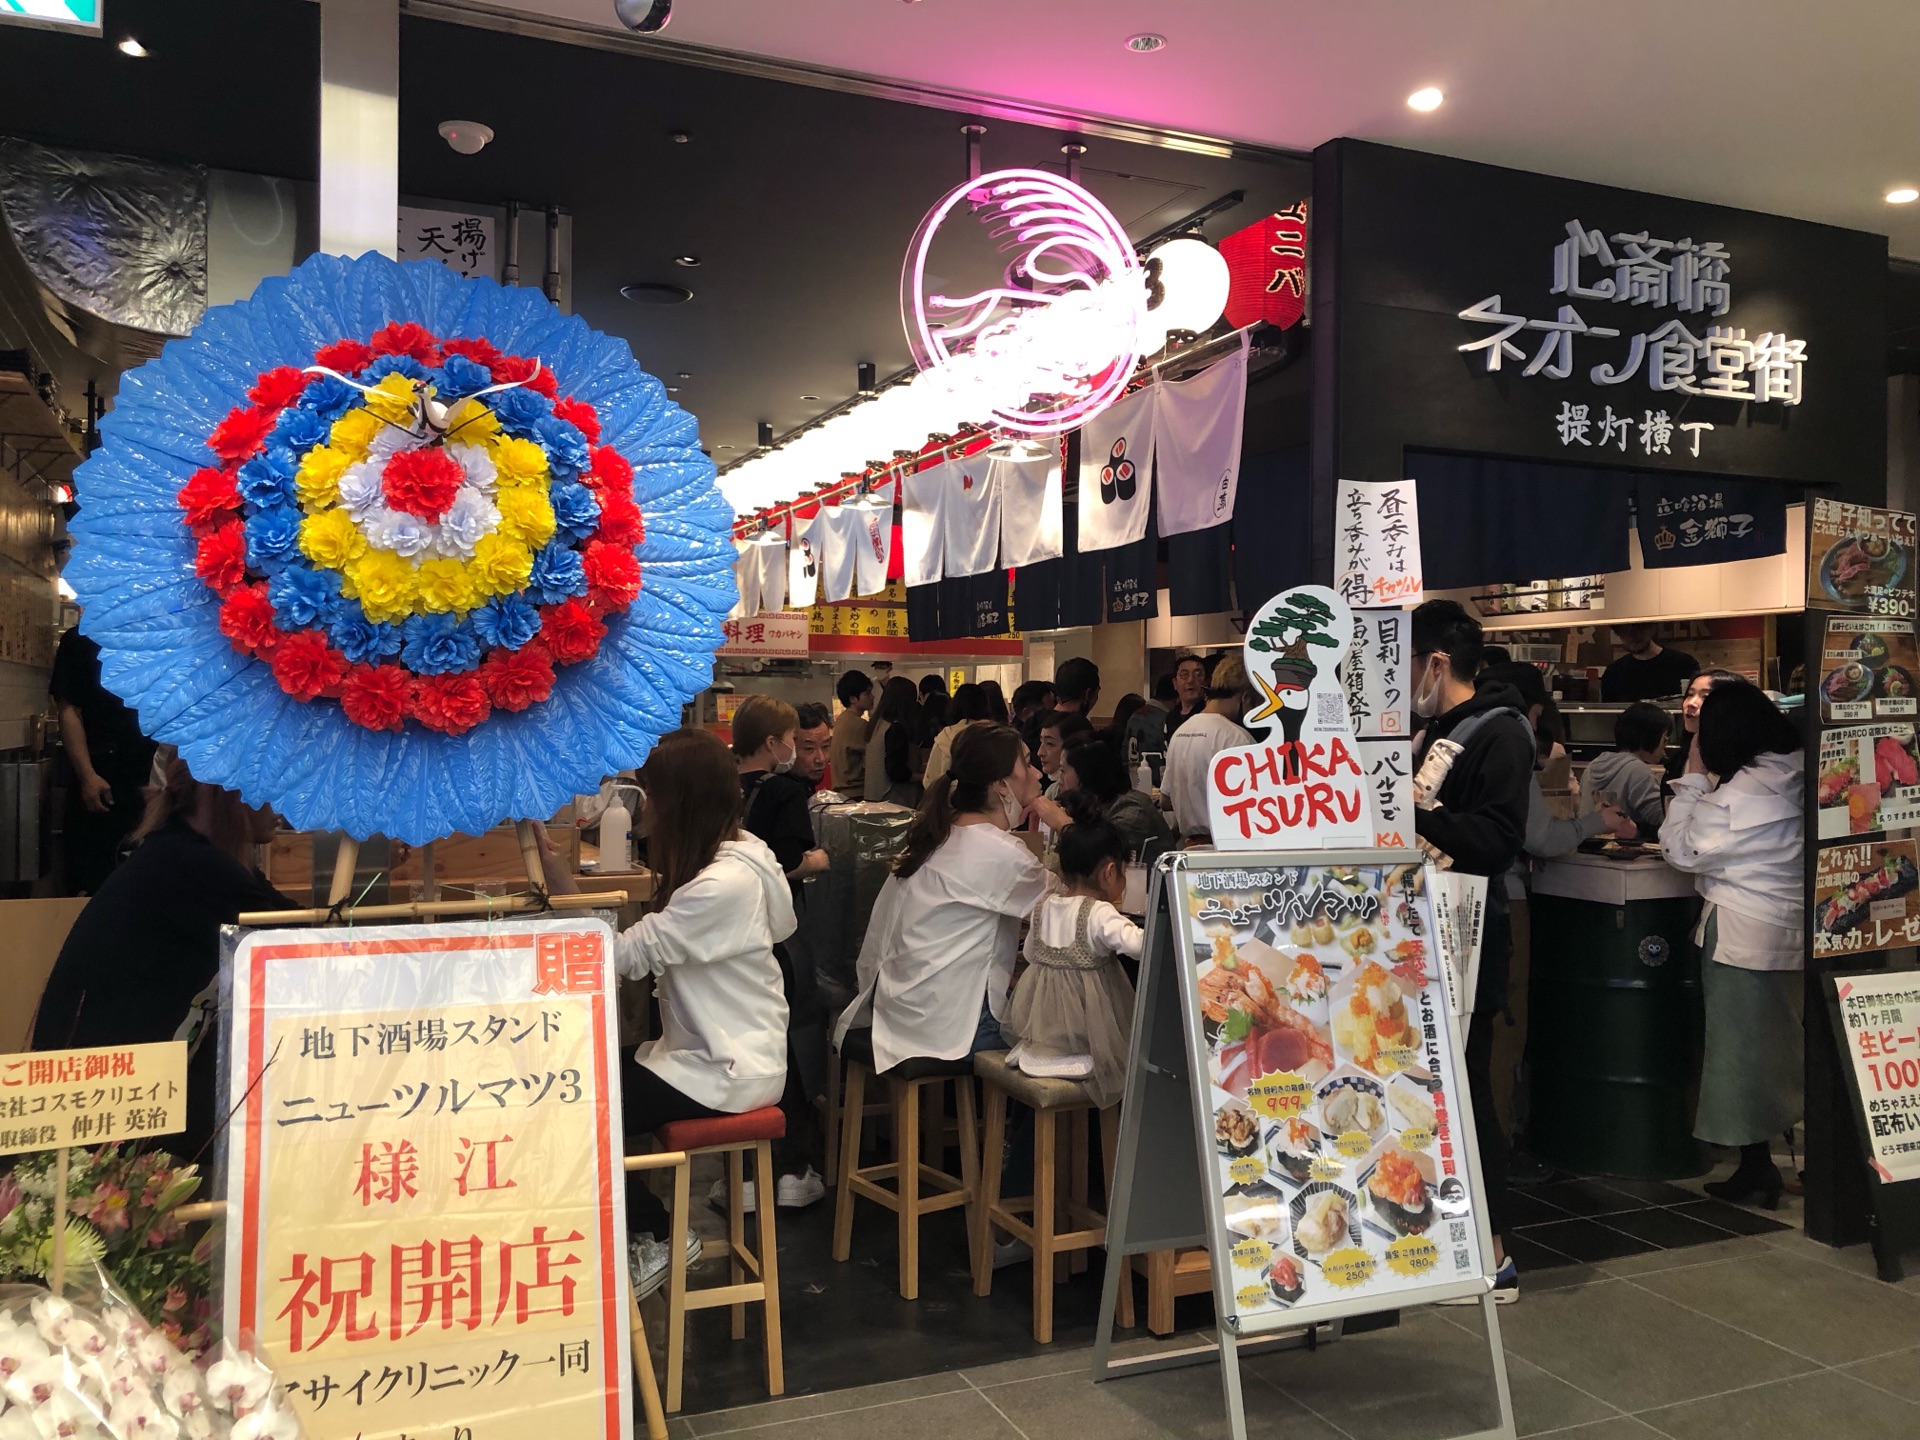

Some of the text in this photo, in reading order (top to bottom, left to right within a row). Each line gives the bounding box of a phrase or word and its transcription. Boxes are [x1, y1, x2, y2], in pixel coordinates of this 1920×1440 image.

[451, 218, 486, 278] 揚げ
[1550, 219, 1731, 317] 心斎橋
[1458, 294, 1808, 406] ネオン食堂街
[1556, 401, 1714, 457] 提灯横丁
[1377, 488, 1409, 573] 昼呑みは
[1377, 617, 1401, 709] 目利きの
[1214, 737, 1362, 797] CHIKA
[1371, 751, 1409, 821] パルコで
[1223, 782, 1361, 839] TSURU
[1197, 871, 1298, 890] 地下酒場スタンド
[1818, 845, 1872, 873] これが!!
[531, 932, 605, 995] 贈
[299, 1010, 562, 1060] 地下酒場スタンド
[1859, 1026, 1920, 1059] 生ビー
[2, 1051, 136, 1087] ご開店御祝
[277, 1068, 582, 1127] ニューツルマツ3
[1868, 1058, 1920, 1092] 100
[71, 1112, 116, 1140] 仲井
[125, 1106, 168, 1133] 英治
[1869, 1094, 1920, 1112] めちゃええ
[352, 1134, 517, 1206] 様 江
[275, 1227, 585, 1352] 祝開店
